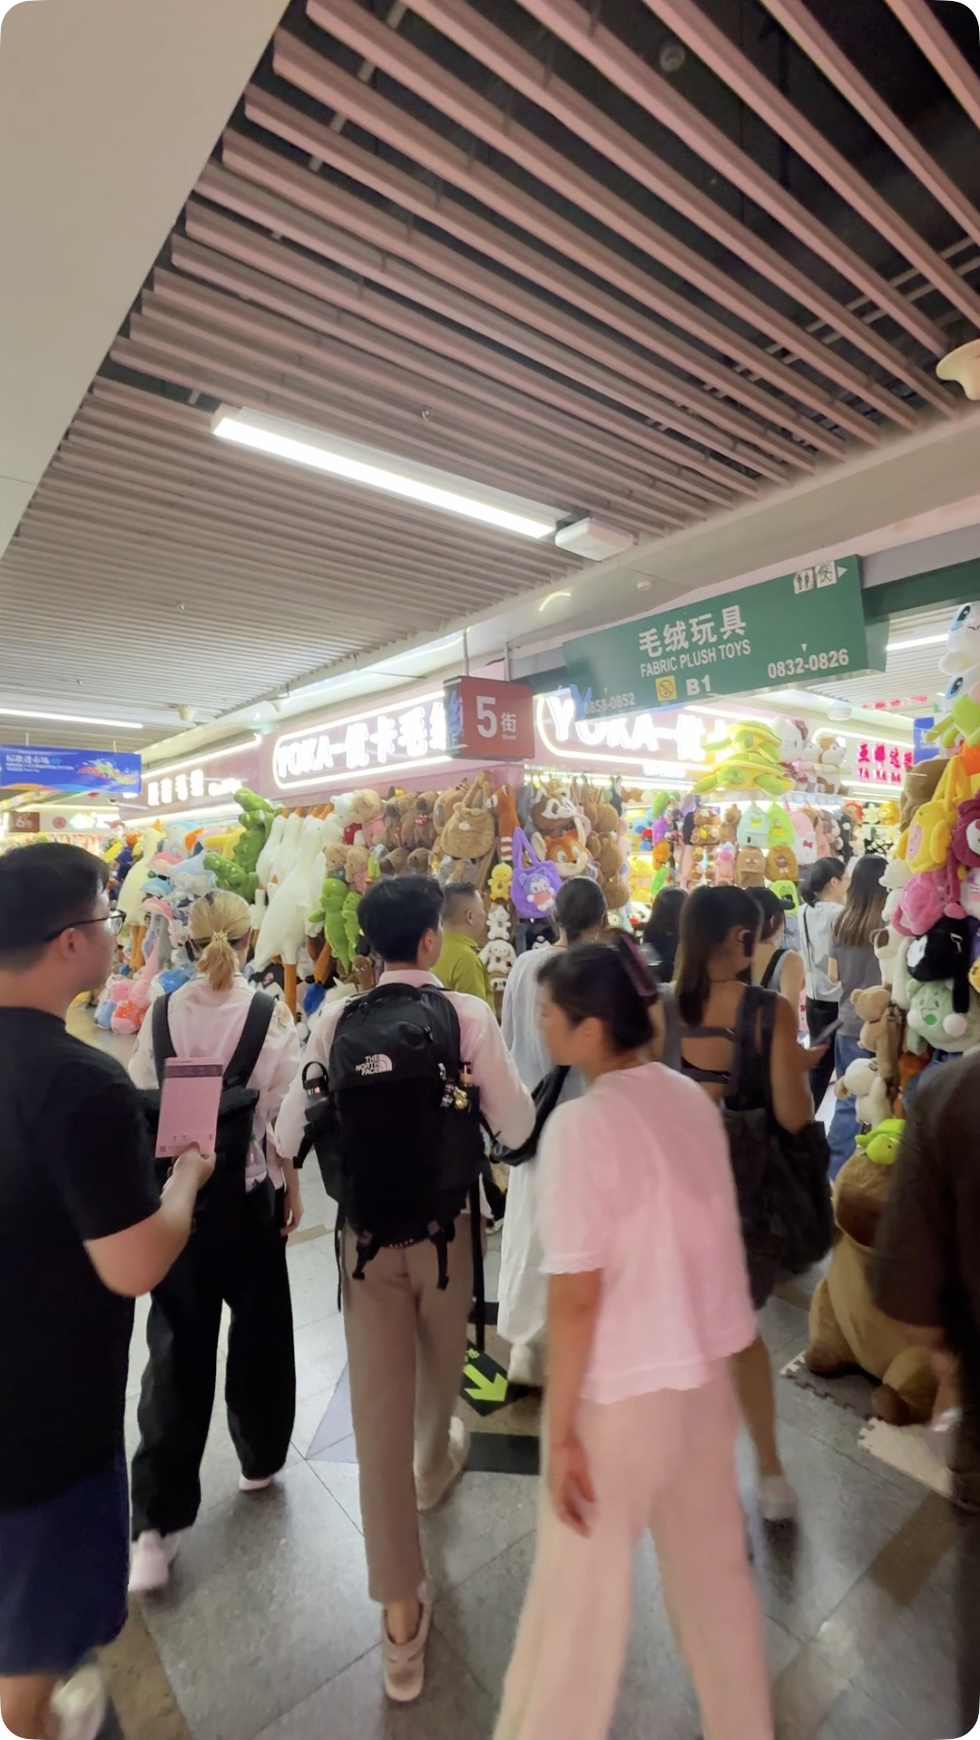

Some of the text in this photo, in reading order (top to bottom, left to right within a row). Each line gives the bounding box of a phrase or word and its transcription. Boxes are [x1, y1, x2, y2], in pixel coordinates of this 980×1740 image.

[639, 605, 746, 658] 毛绒玩具
[640, 639, 751, 678] FABRIC PLUSH TOYS
[768, 648, 849, 679] 0832-0826
[686, 675, 712, 696] B1
[355, 1061, 379, 1071] NORTH
[364, 1054, 379, 1063] THE
[361, 1068, 379, 1076] FACE
